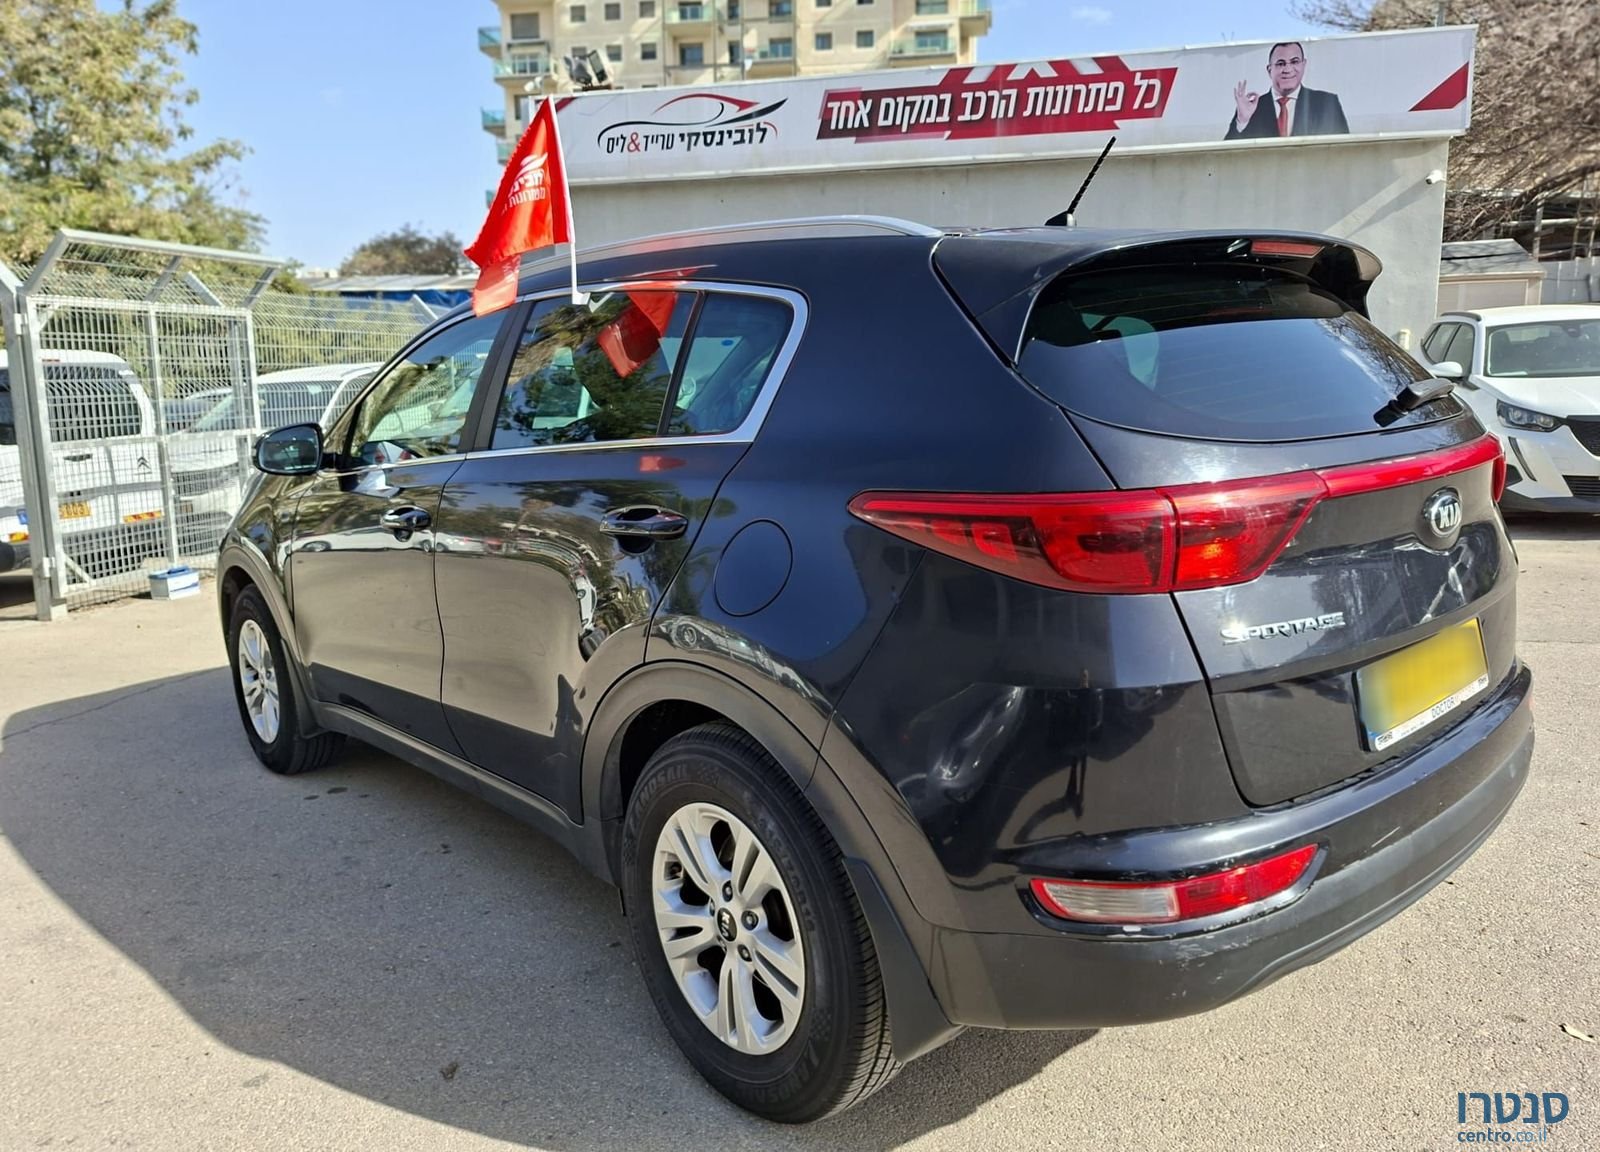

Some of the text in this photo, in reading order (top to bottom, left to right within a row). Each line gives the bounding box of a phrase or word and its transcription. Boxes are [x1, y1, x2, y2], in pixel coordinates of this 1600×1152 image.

[827, 72, 1162, 133] כל פתרונות הרכב במקום אחד
[678, 122, 768, 152] לובינסקי
[1438, 502, 1461, 529] KIA
[1220, 611, 1346, 646] SPORTAGE
[1431, 697, 1456, 719] DOCTOR
[721, 911, 731, 937] KIA
